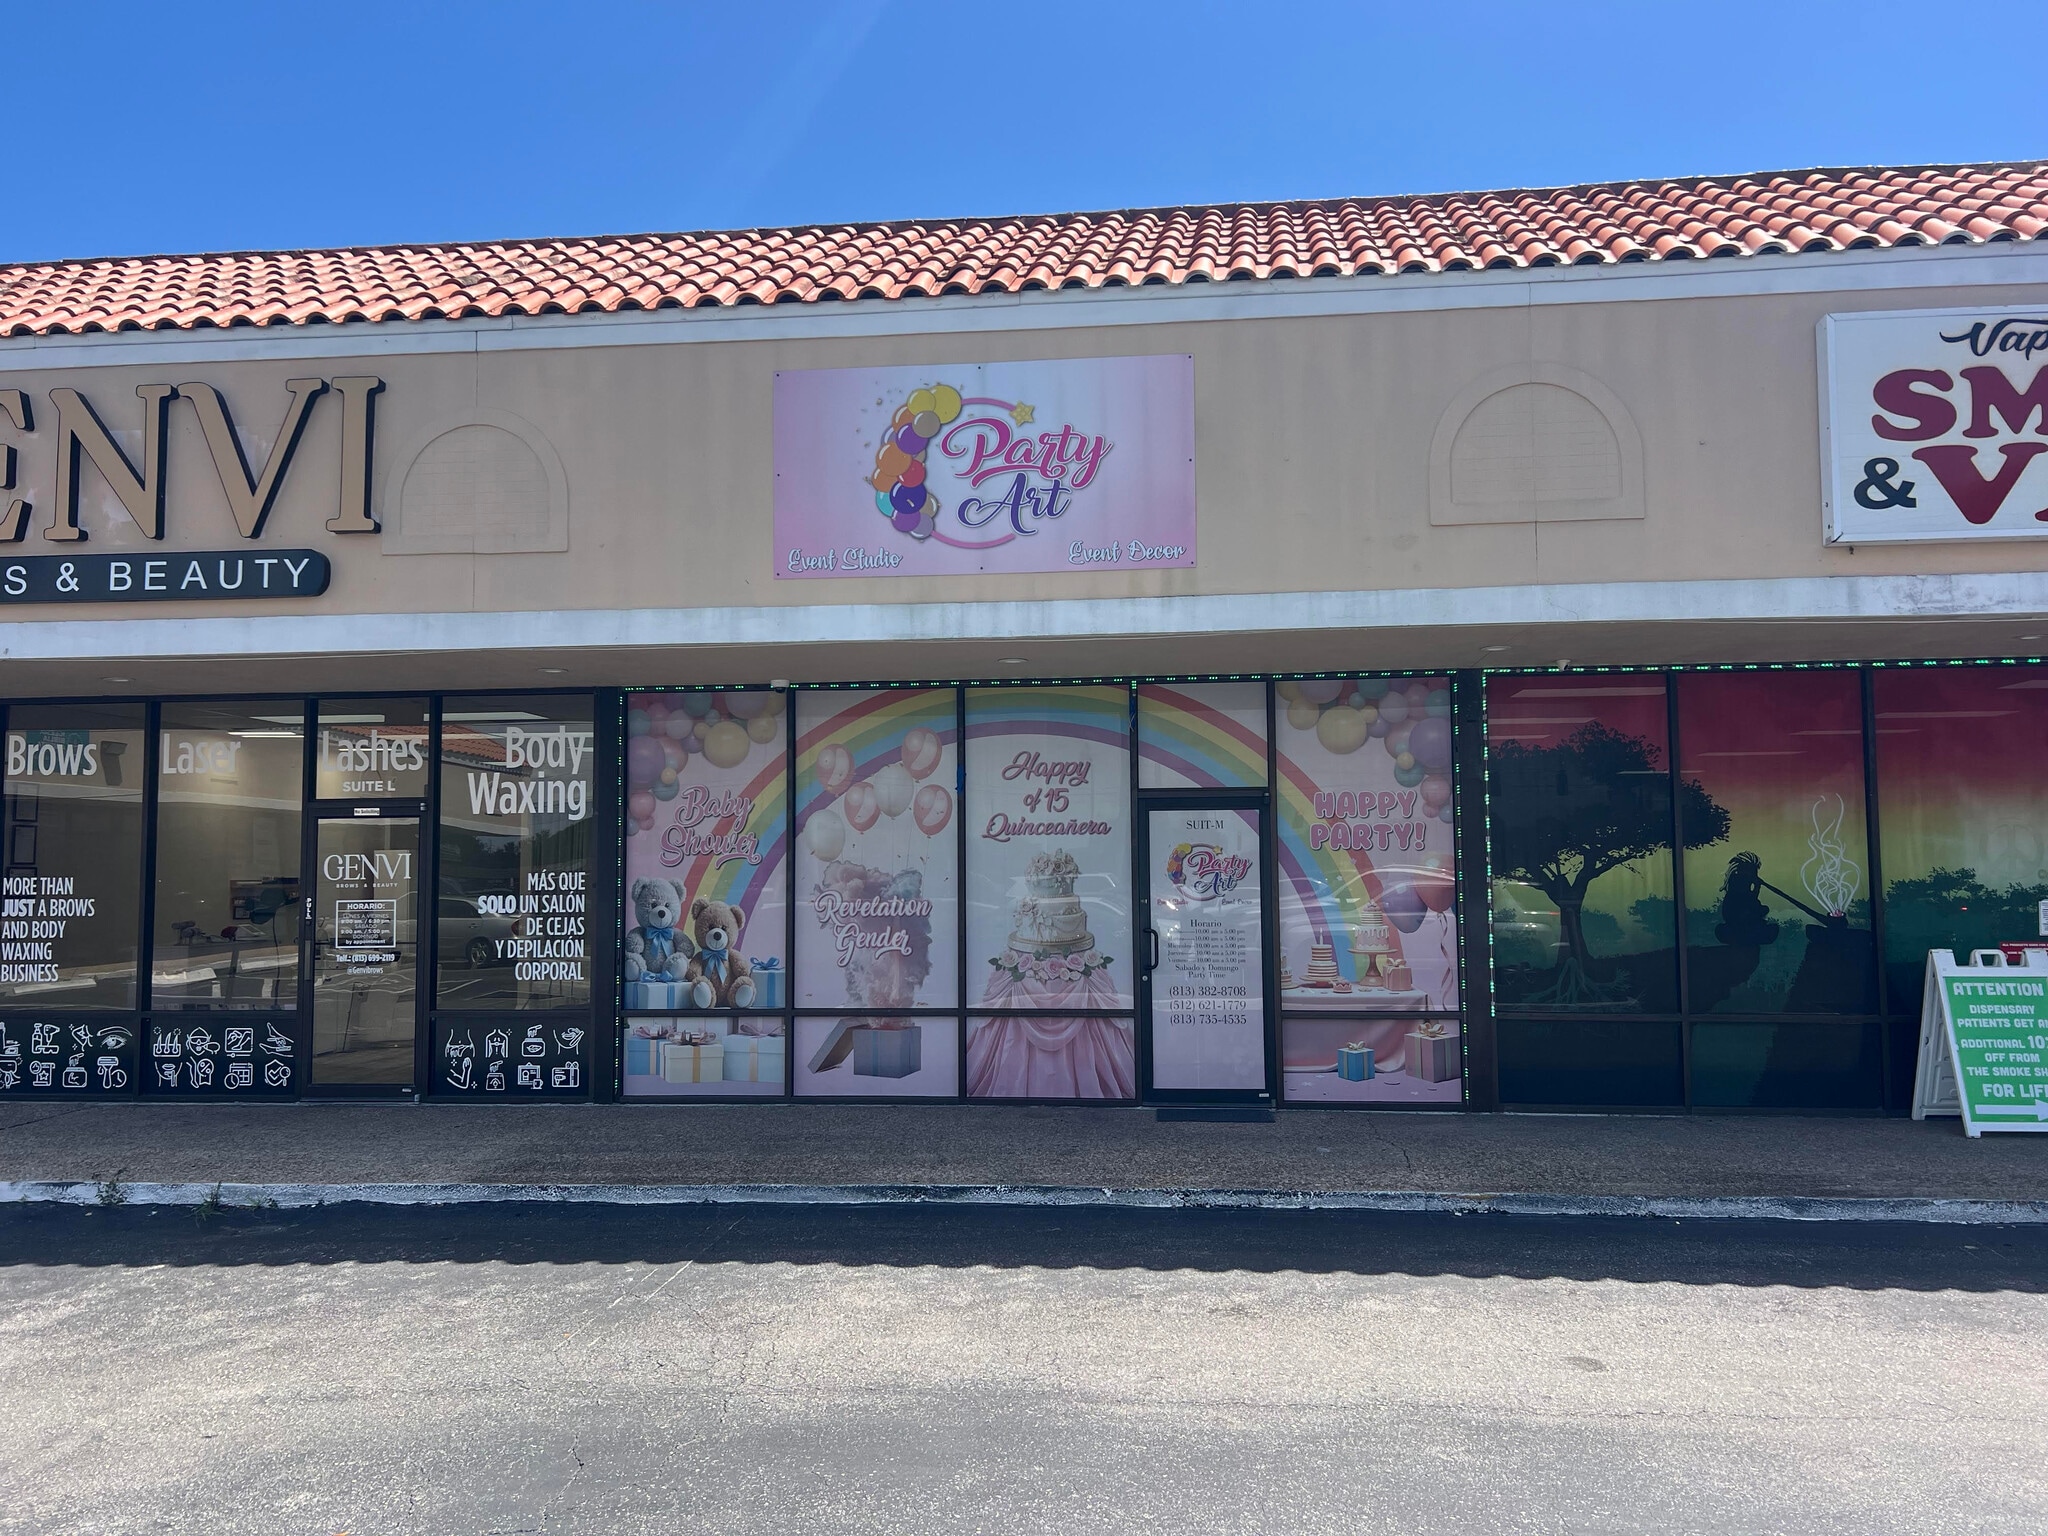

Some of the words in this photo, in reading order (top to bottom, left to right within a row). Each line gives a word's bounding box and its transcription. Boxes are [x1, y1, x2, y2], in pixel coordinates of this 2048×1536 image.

[940, 416, 1114, 489] Party
[1854, 457, 1917, 510] &
[1912, 442, 2048, 525] V
[957, 471, 1073, 535] Art
[787, 547, 839, 573] Event
[841, 546, 903, 572] Studio
[1068, 539, 1121, 565] Event
[1126, 539, 1188, 563] Decor
[55, 561, 80, 593] &
[108, 557, 310, 592] BEAUTY
[7, 734, 97, 776] Brows
[162, 734, 241, 775] Laser
[322, 730, 424, 772] Lashes
[506, 726, 588, 775] Body
[1000, 750, 1092, 787] Happy
[342, 780, 383, 792] SUITE
[387, 780, 396, 792] L
[467, 772, 588, 821] Waxing
[674, 785, 755, 832] Baby
[1044, 787, 1070, 811] 15
[1312, 790, 1418, 819] HAPPY
[982, 812, 1112, 843] Quinceañera
[1186, 819, 1224, 830] SUIT-M
[1309, 822, 1427, 851] PARTY!
[659, 827, 763, 870] Shower
[323, 853, 411, 881] GENVI
[1187, 850, 1253, 881] Party
[3, 877, 37, 896] MORE
[40, 877, 74, 895] THAN
[527, 868, 556, 892] MÁS
[559, 872, 586, 893] QUE
[1194, 872, 1238, 897] Art
[2, 900, 35, 918] JUST
[37, 899, 47, 917] A
[49, 899, 95, 917] BROWS
[477, 895, 516, 914] SOLO
[519, 895, 539, 914] UN
[541, 892, 586, 914] SALÓN
[815, 890, 933, 923] Revelation
[2, 921, 28, 939] AND
[32, 920, 66, 939] BODY
[526, 918, 545, 936] DE
[547, 917, 586, 936] CEJAS
[1190, 919, 1222, 927] Horario
[2, 943, 52, 961] WAXING
[495, 940, 505, 959] Y
[507, 936, 584, 959] DEPILACIÓN
[833, 922, 913, 968] Gender
[1, 964, 59, 982] BUSINESS
[347, 966, 384, 975] @Genvibrows
[514, 962, 585, 981] CORPORAL
[1188, 971, 1206, 979] Party
[1208, 964, 1239, 972] Domingo
[1169, 985, 1195, 999] (813)
[1198, 985, 1247, 997] 382-8708
[1953, 982, 2044, 996] ATTENTION
[1169, 1000, 1195, 1012] (512)
[1198, 1000, 1247, 1011] 621-1779
[1969, 1004, 2035, 1014] DISPENSARY
[1170, 1013, 1196, 1026] (813)
[1199, 1013, 1247, 1025] 735-4535
[1957, 1018, 2011, 1028] PATIENTS
[2013, 1018, 2034, 1028] GET
[1961, 1039, 2026, 1049] ADDITIONAL
[2027, 1035, 2048, 1049] 10
[1984, 1052, 2006, 1062] OFF
[2008, 1052, 2040, 1063] FROM
[1966, 1066, 1990, 1076] THE
[1992, 1066, 2032, 1077] SMOKE
[1982, 1083, 2016, 1098] FOR
